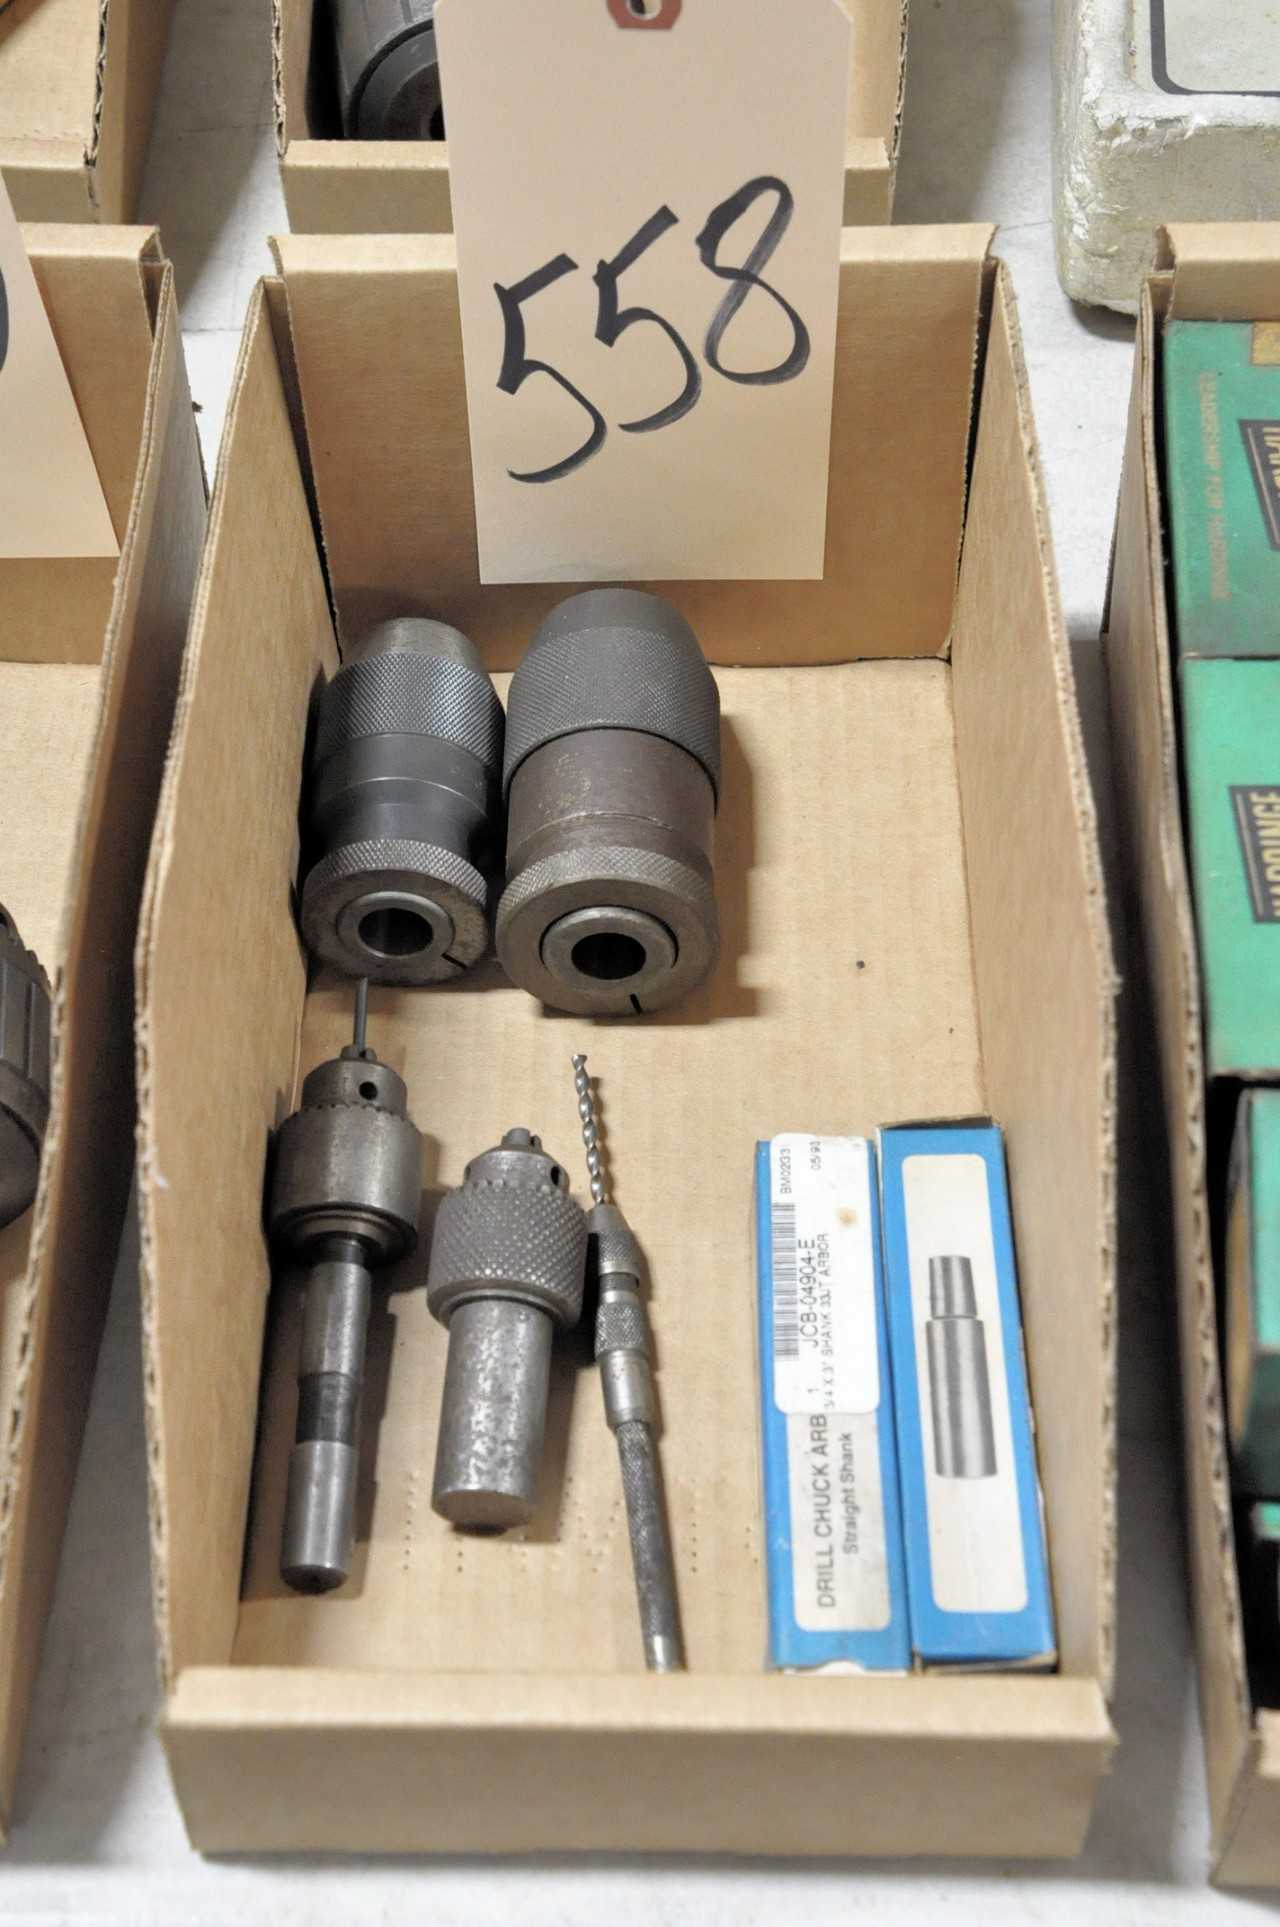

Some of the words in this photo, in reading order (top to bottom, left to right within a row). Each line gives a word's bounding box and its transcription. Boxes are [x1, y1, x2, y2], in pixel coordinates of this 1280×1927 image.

[494, 175, 811, 484] 558
[816, 1232, 831, 1278] ARBOR
[798, 1239, 818, 1349] JCB-04904-E
[819, 1312, 834, 1356] SHANK
[810, 1413, 831, 1457] ARB
[838, 1432, 856, 1484] Shank
[812, 1463, 833, 1539] CHUCK
[841, 1486, 861, 1555] Straight
[817, 1543, 836, 1608] DRILL
